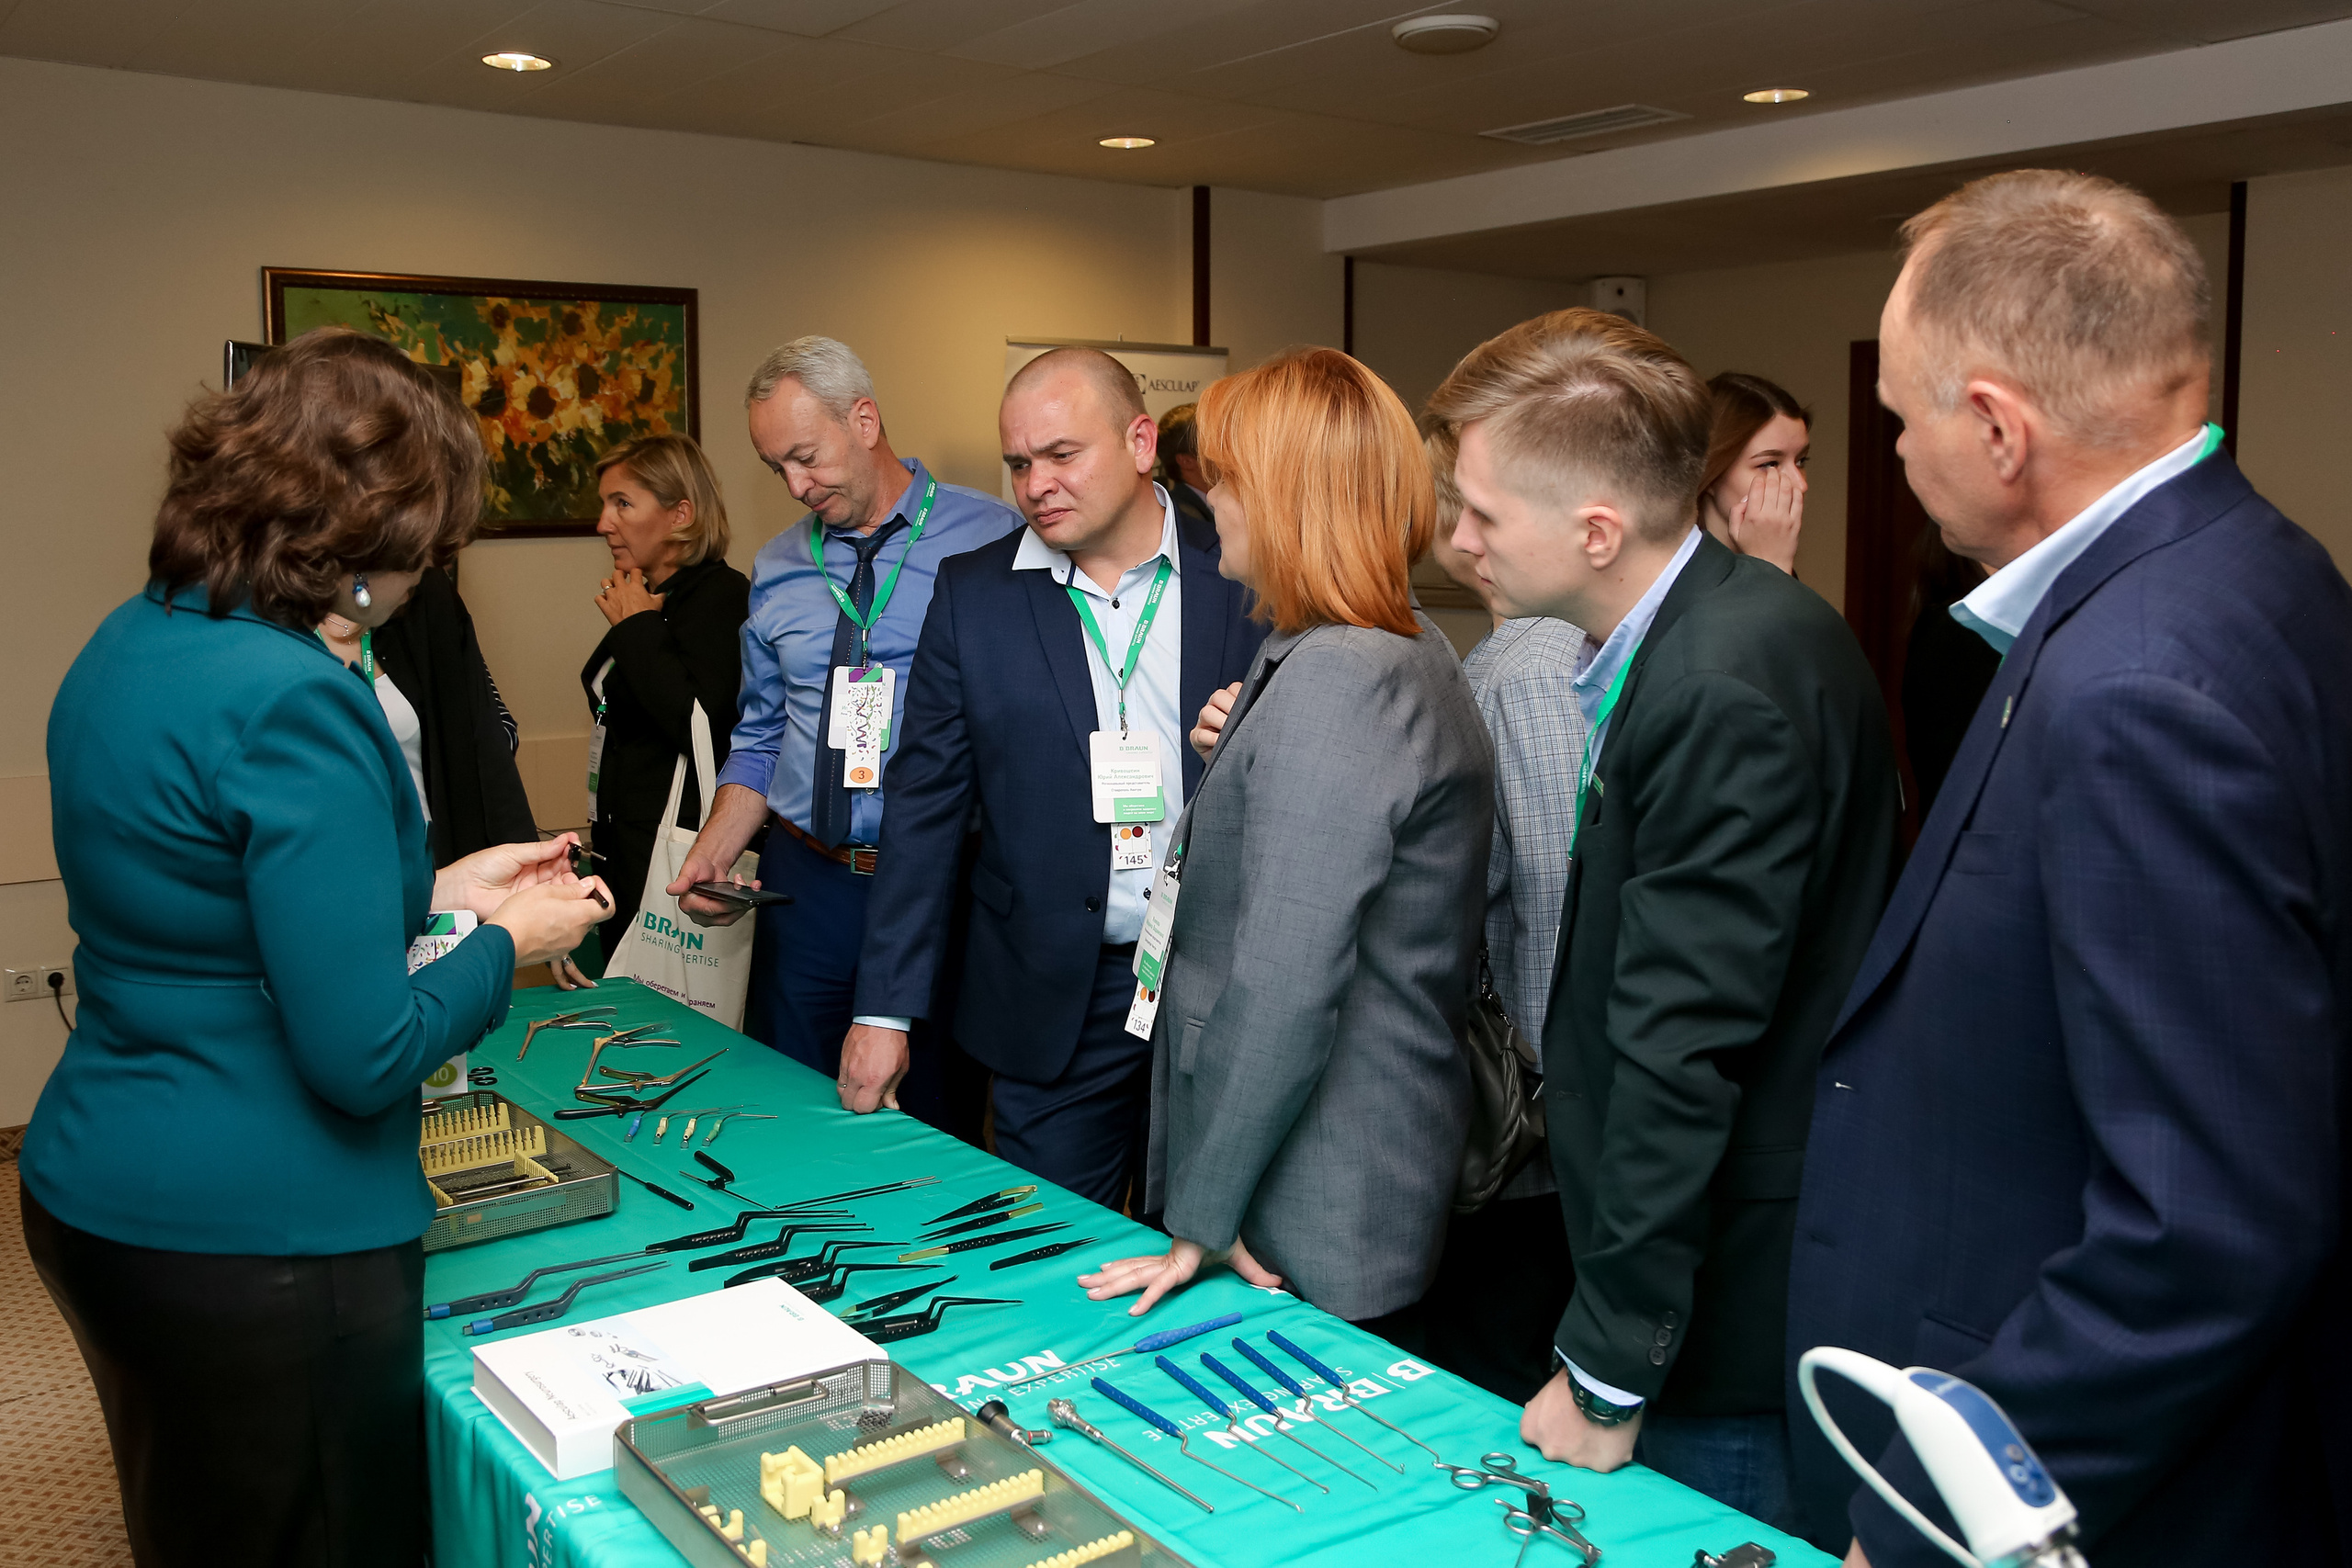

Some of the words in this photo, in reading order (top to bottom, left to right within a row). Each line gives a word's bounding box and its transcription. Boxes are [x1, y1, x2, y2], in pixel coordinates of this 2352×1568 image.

[858, 770, 865, 780] 3
[1124, 855, 1144, 865] 145
[640, 931, 681, 953] SHARING
[682, 953, 719, 968] ERTISE
[646, 980, 679, 997] оберегаем
[688, 999, 716, 1009] раняем
[1133, 1019, 1146, 1032] 134
[433, 1067, 449, 1082] 10
[929, 1349, 1067, 1401] RAUN
[1260, 1366, 1353, 1402] SARNG
